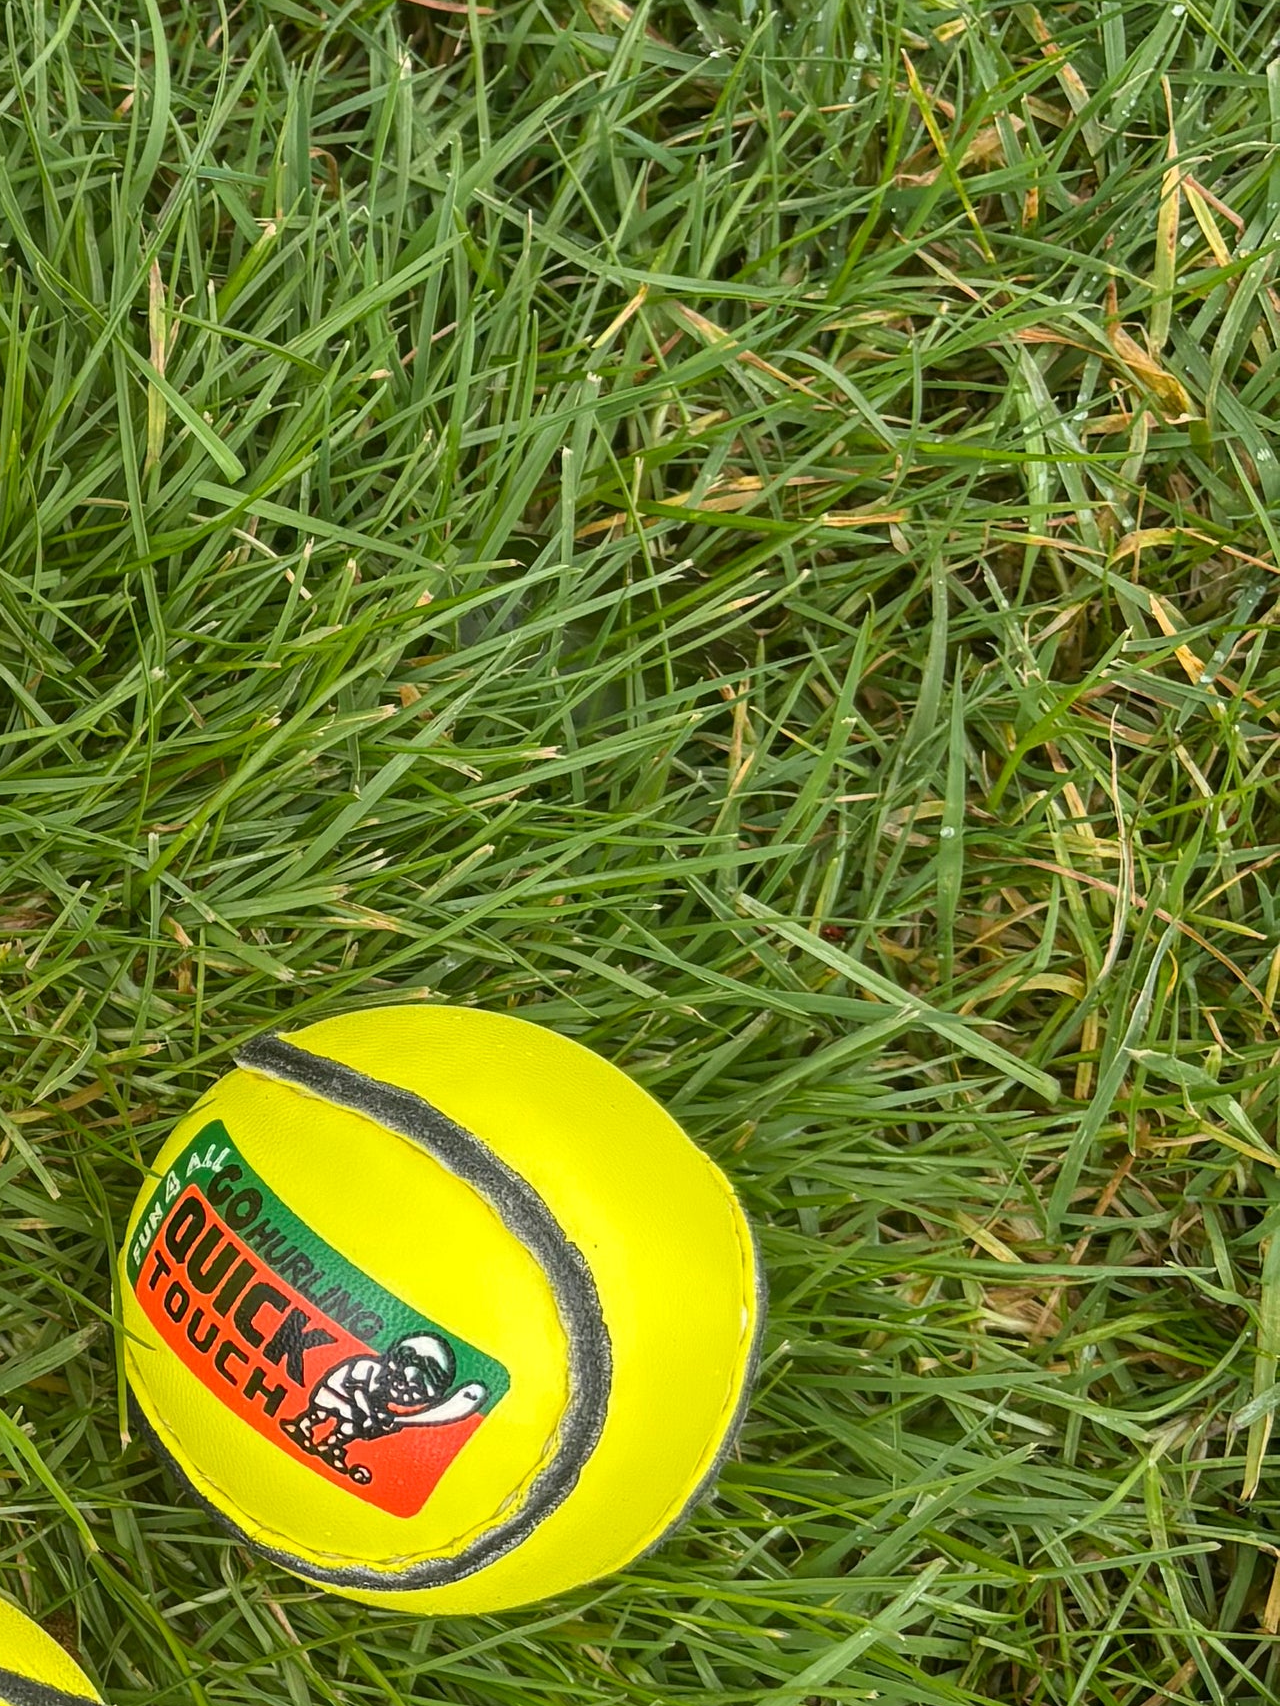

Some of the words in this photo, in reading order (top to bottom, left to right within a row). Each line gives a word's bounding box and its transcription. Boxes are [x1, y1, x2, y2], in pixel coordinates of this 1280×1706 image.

[132, 1201, 163, 1266] FUN
[165, 1170, 181, 1204] 4
[185, 1143, 231, 1178] ALL
[148, 1249, 288, 1418] TOUCH
[165, 1195, 339, 1388] QUICK
